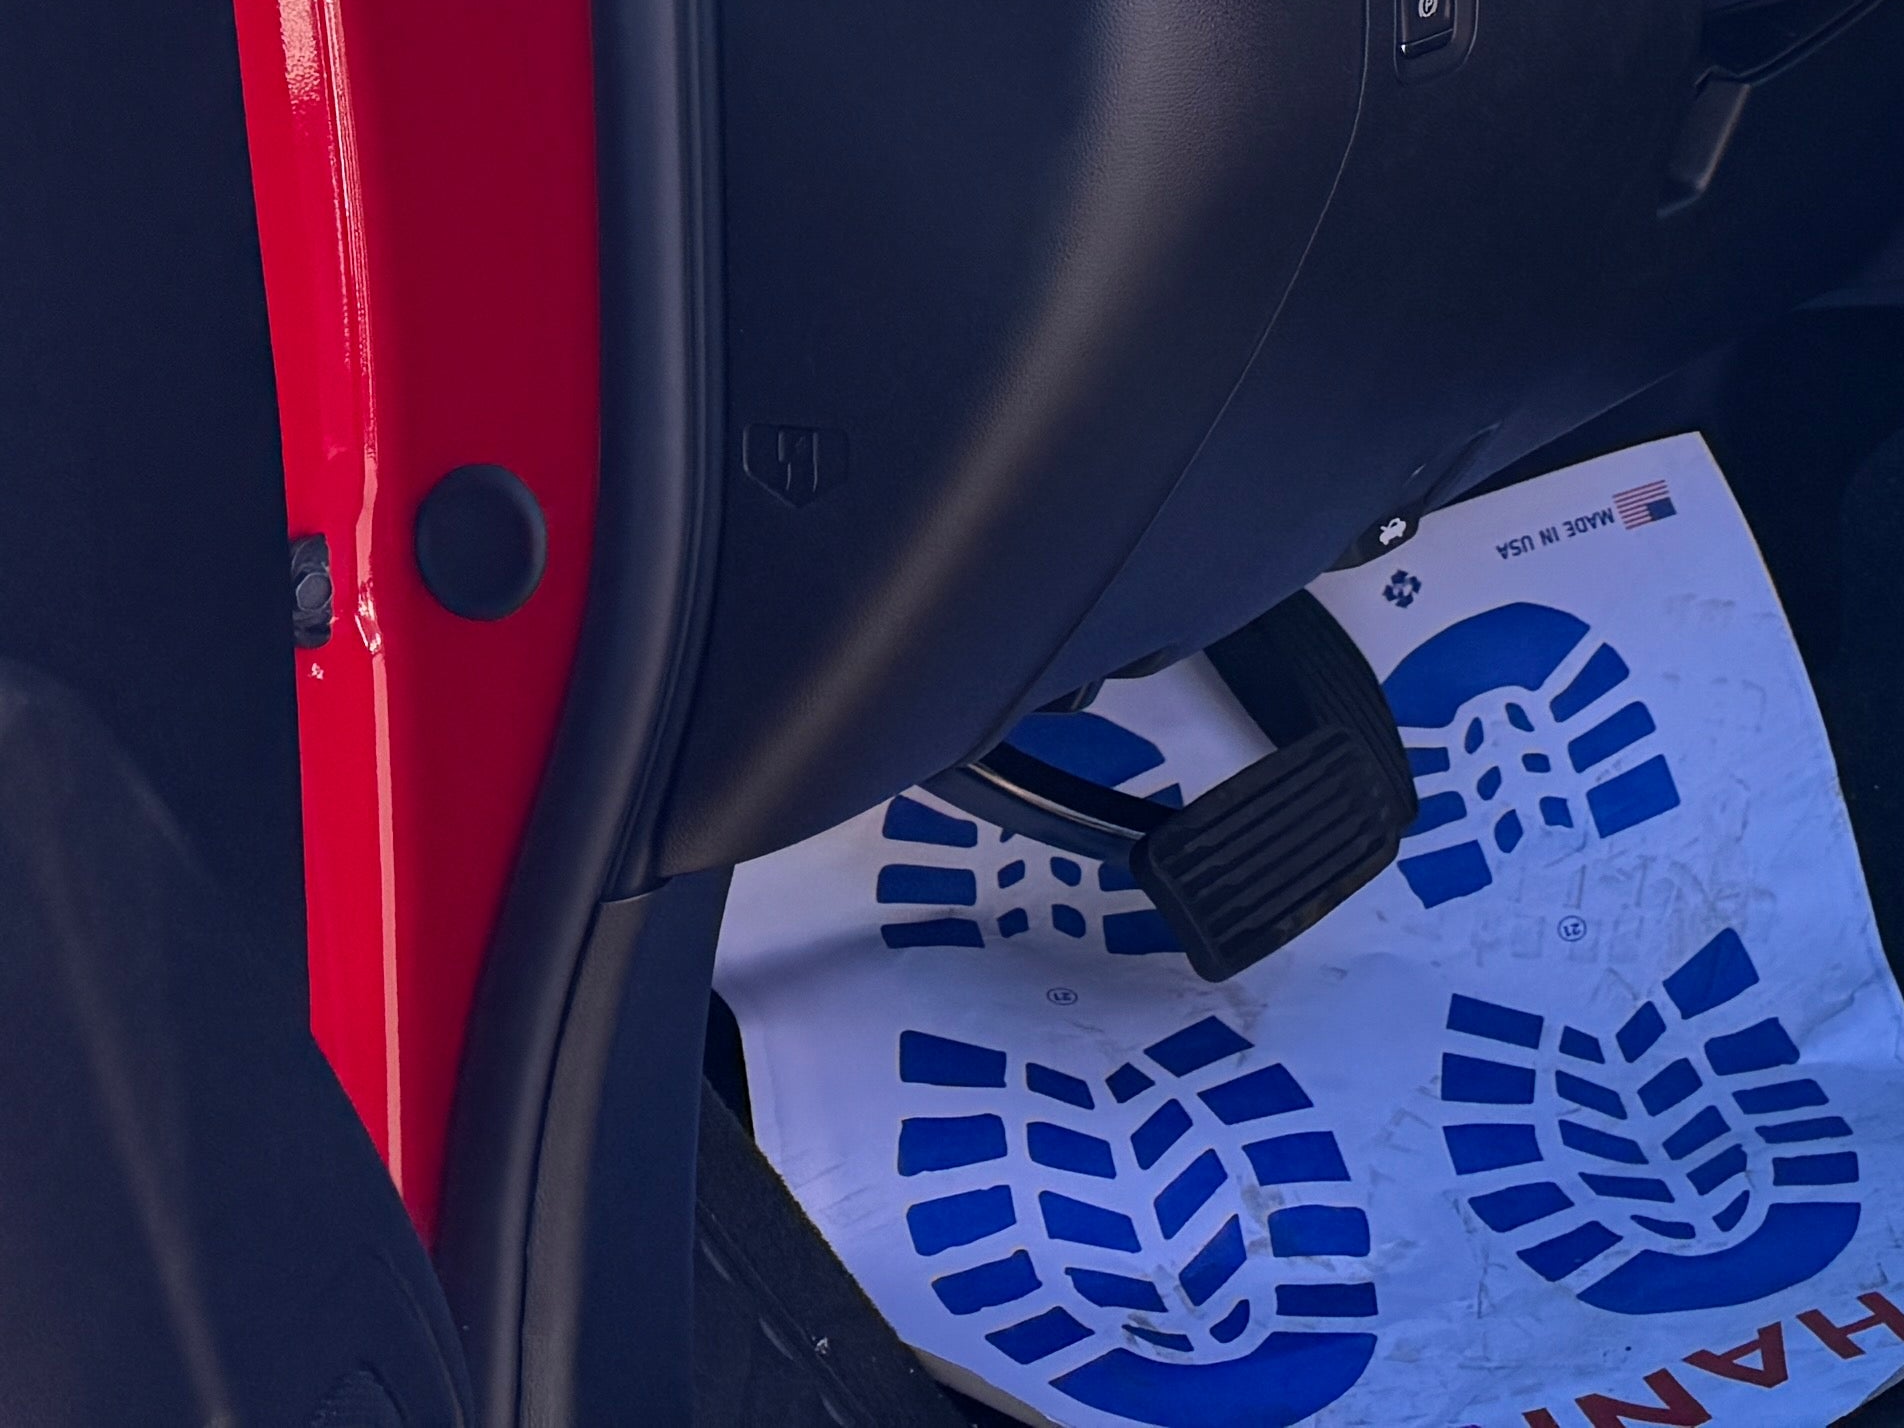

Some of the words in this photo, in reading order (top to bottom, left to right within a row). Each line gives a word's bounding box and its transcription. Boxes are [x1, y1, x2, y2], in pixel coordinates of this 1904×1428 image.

[1565, 506, 1616, 538] MADE
[1494, 534, 1536, 560] USA
[1539, 526, 1561, 546] IN
